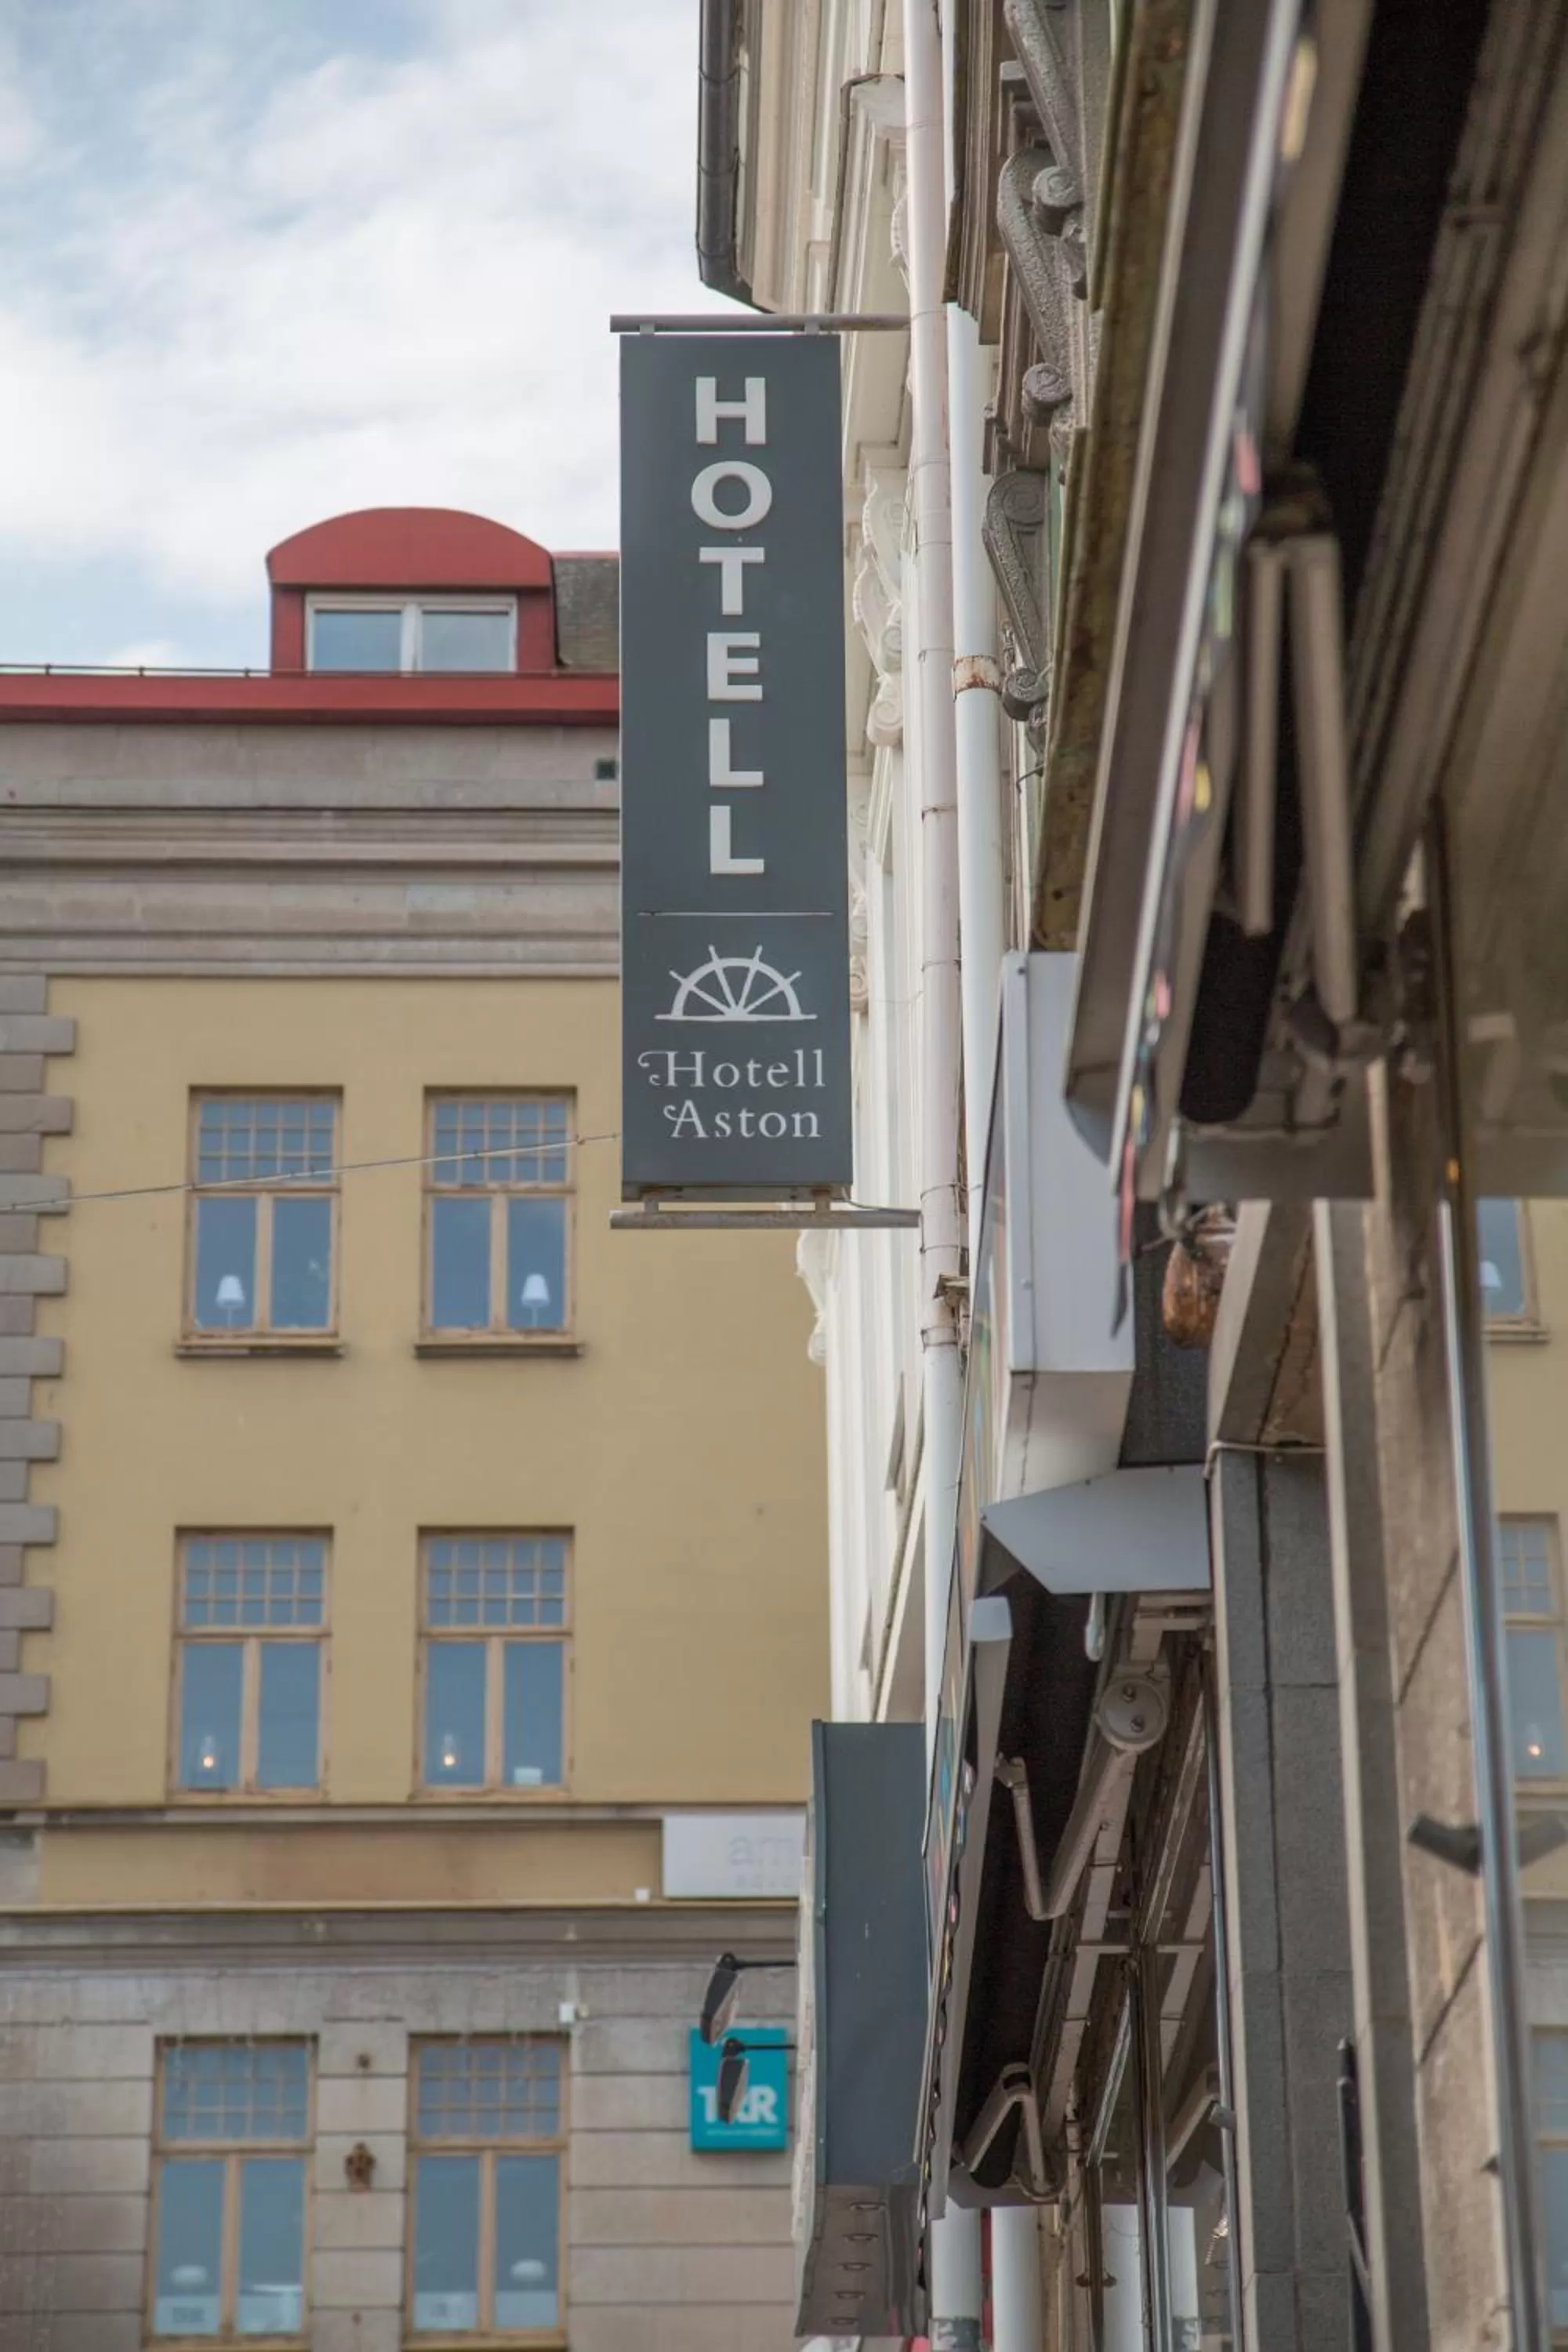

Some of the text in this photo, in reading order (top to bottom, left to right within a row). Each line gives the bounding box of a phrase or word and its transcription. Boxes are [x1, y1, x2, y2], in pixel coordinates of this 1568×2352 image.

[690, 376, 772, 874] HOTELL
[637, 1049, 826, 1088] Hotell
[662, 1099, 822, 1138] Aston
